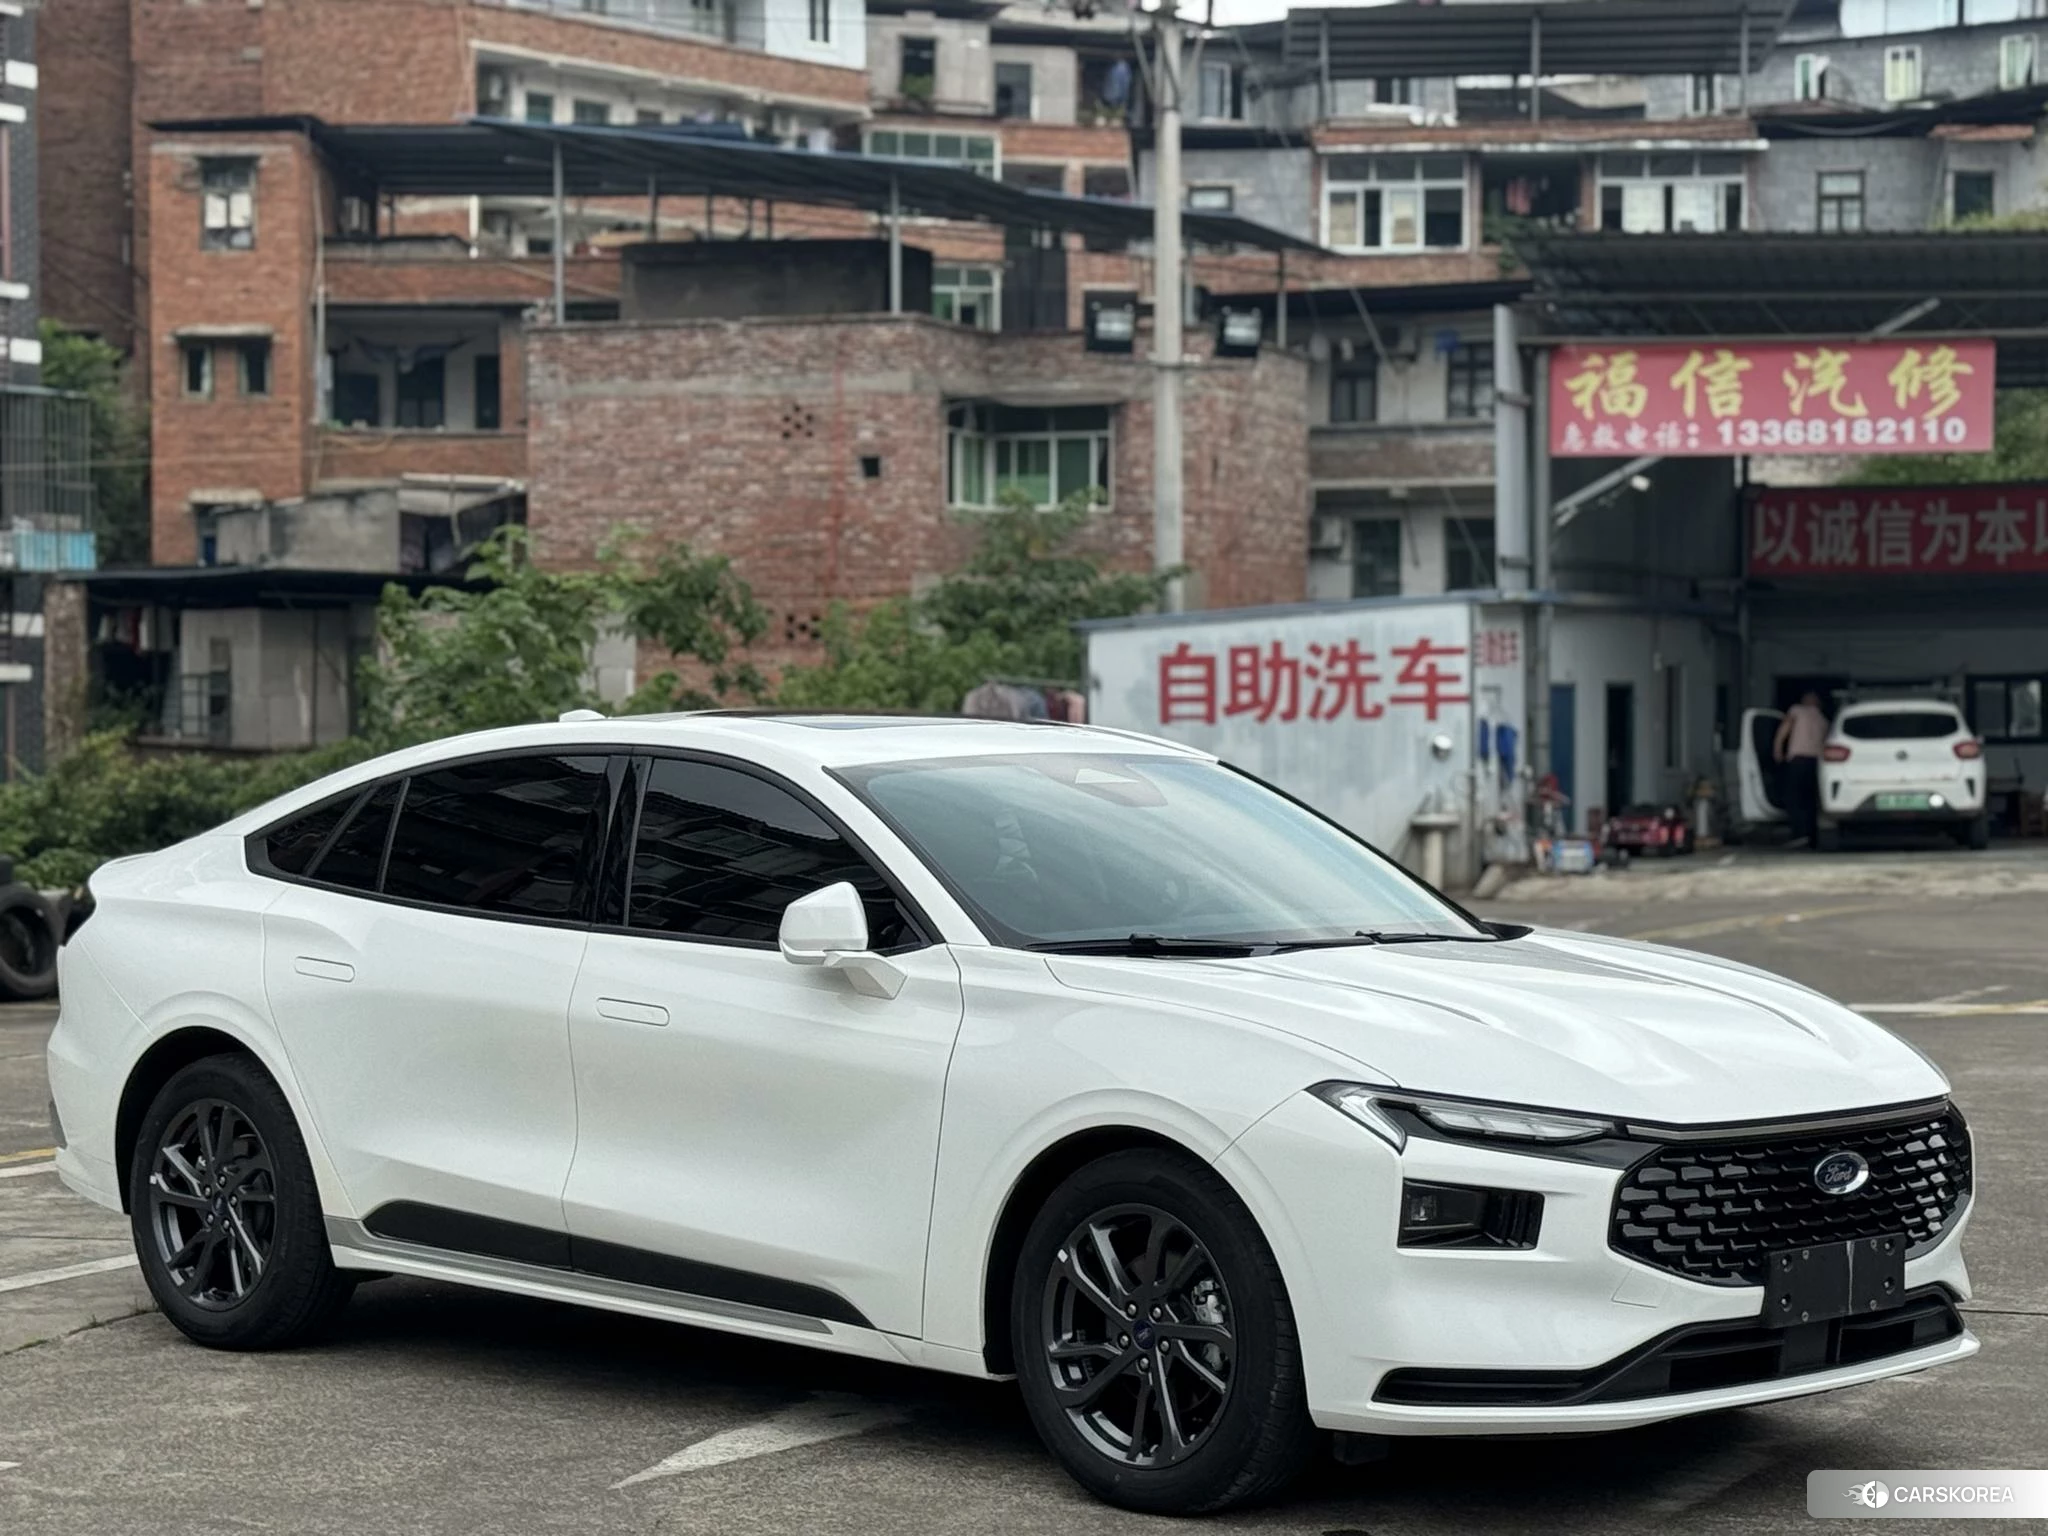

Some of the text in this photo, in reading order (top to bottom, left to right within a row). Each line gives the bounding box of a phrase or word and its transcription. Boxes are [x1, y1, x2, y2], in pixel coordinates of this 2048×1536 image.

[1564, 345, 1974, 421] 福信汽修
[1717, 416, 1967, 446] 13368182110
[1159, 637, 1471, 725] 自助洗车
[1825, 1163, 1853, 1184] Ford
